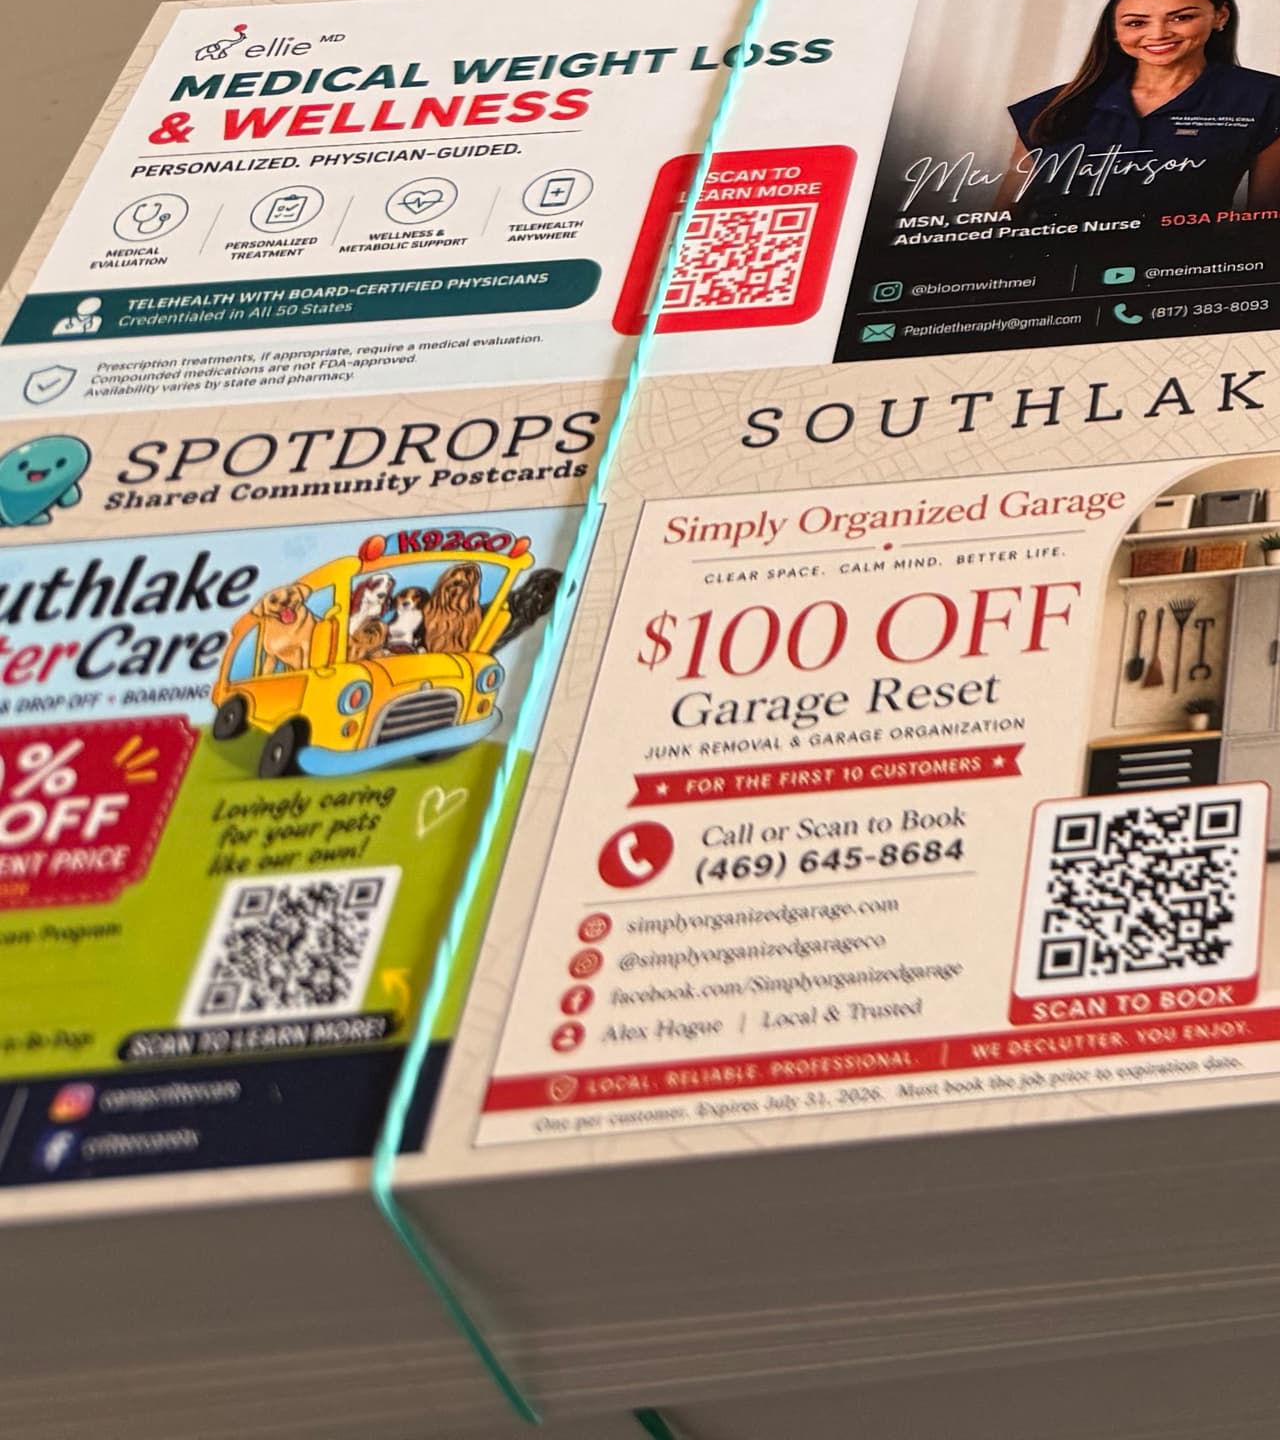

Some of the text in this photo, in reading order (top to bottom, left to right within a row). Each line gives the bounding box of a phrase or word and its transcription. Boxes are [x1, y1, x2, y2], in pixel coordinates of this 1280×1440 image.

[243, 32, 346, 58] ellie MD
[171, 37, 835, 101] MEDICAL WEIGHT LOSS
[148, 89, 592, 145] & WELLNESS
[131, 143, 524, 179] PERSONALIZED. PHYSICIAN-GUIDED.
[894, 216, 1141, 246] Advanced Practice Nurse
[898, 209, 1012, 231] MSN, CRNA
[1160, 212, 1209, 228] 503A
[911, 275, 1036, 298] @bloomwithmei
[1145, 258, 1265, 280] @meimattinson
[1150, 298, 1270, 321] (817) 383-8093
[116, 410, 603, 486] SPOTDROPS
[104, 458, 589, 512] Shared Community Postcards
[662, 486, 1127, 550] Simply Organized Garage
[636, 580, 1084, 682] $100 OFF
[693, 838, 966, 885] (469) 645-8684
